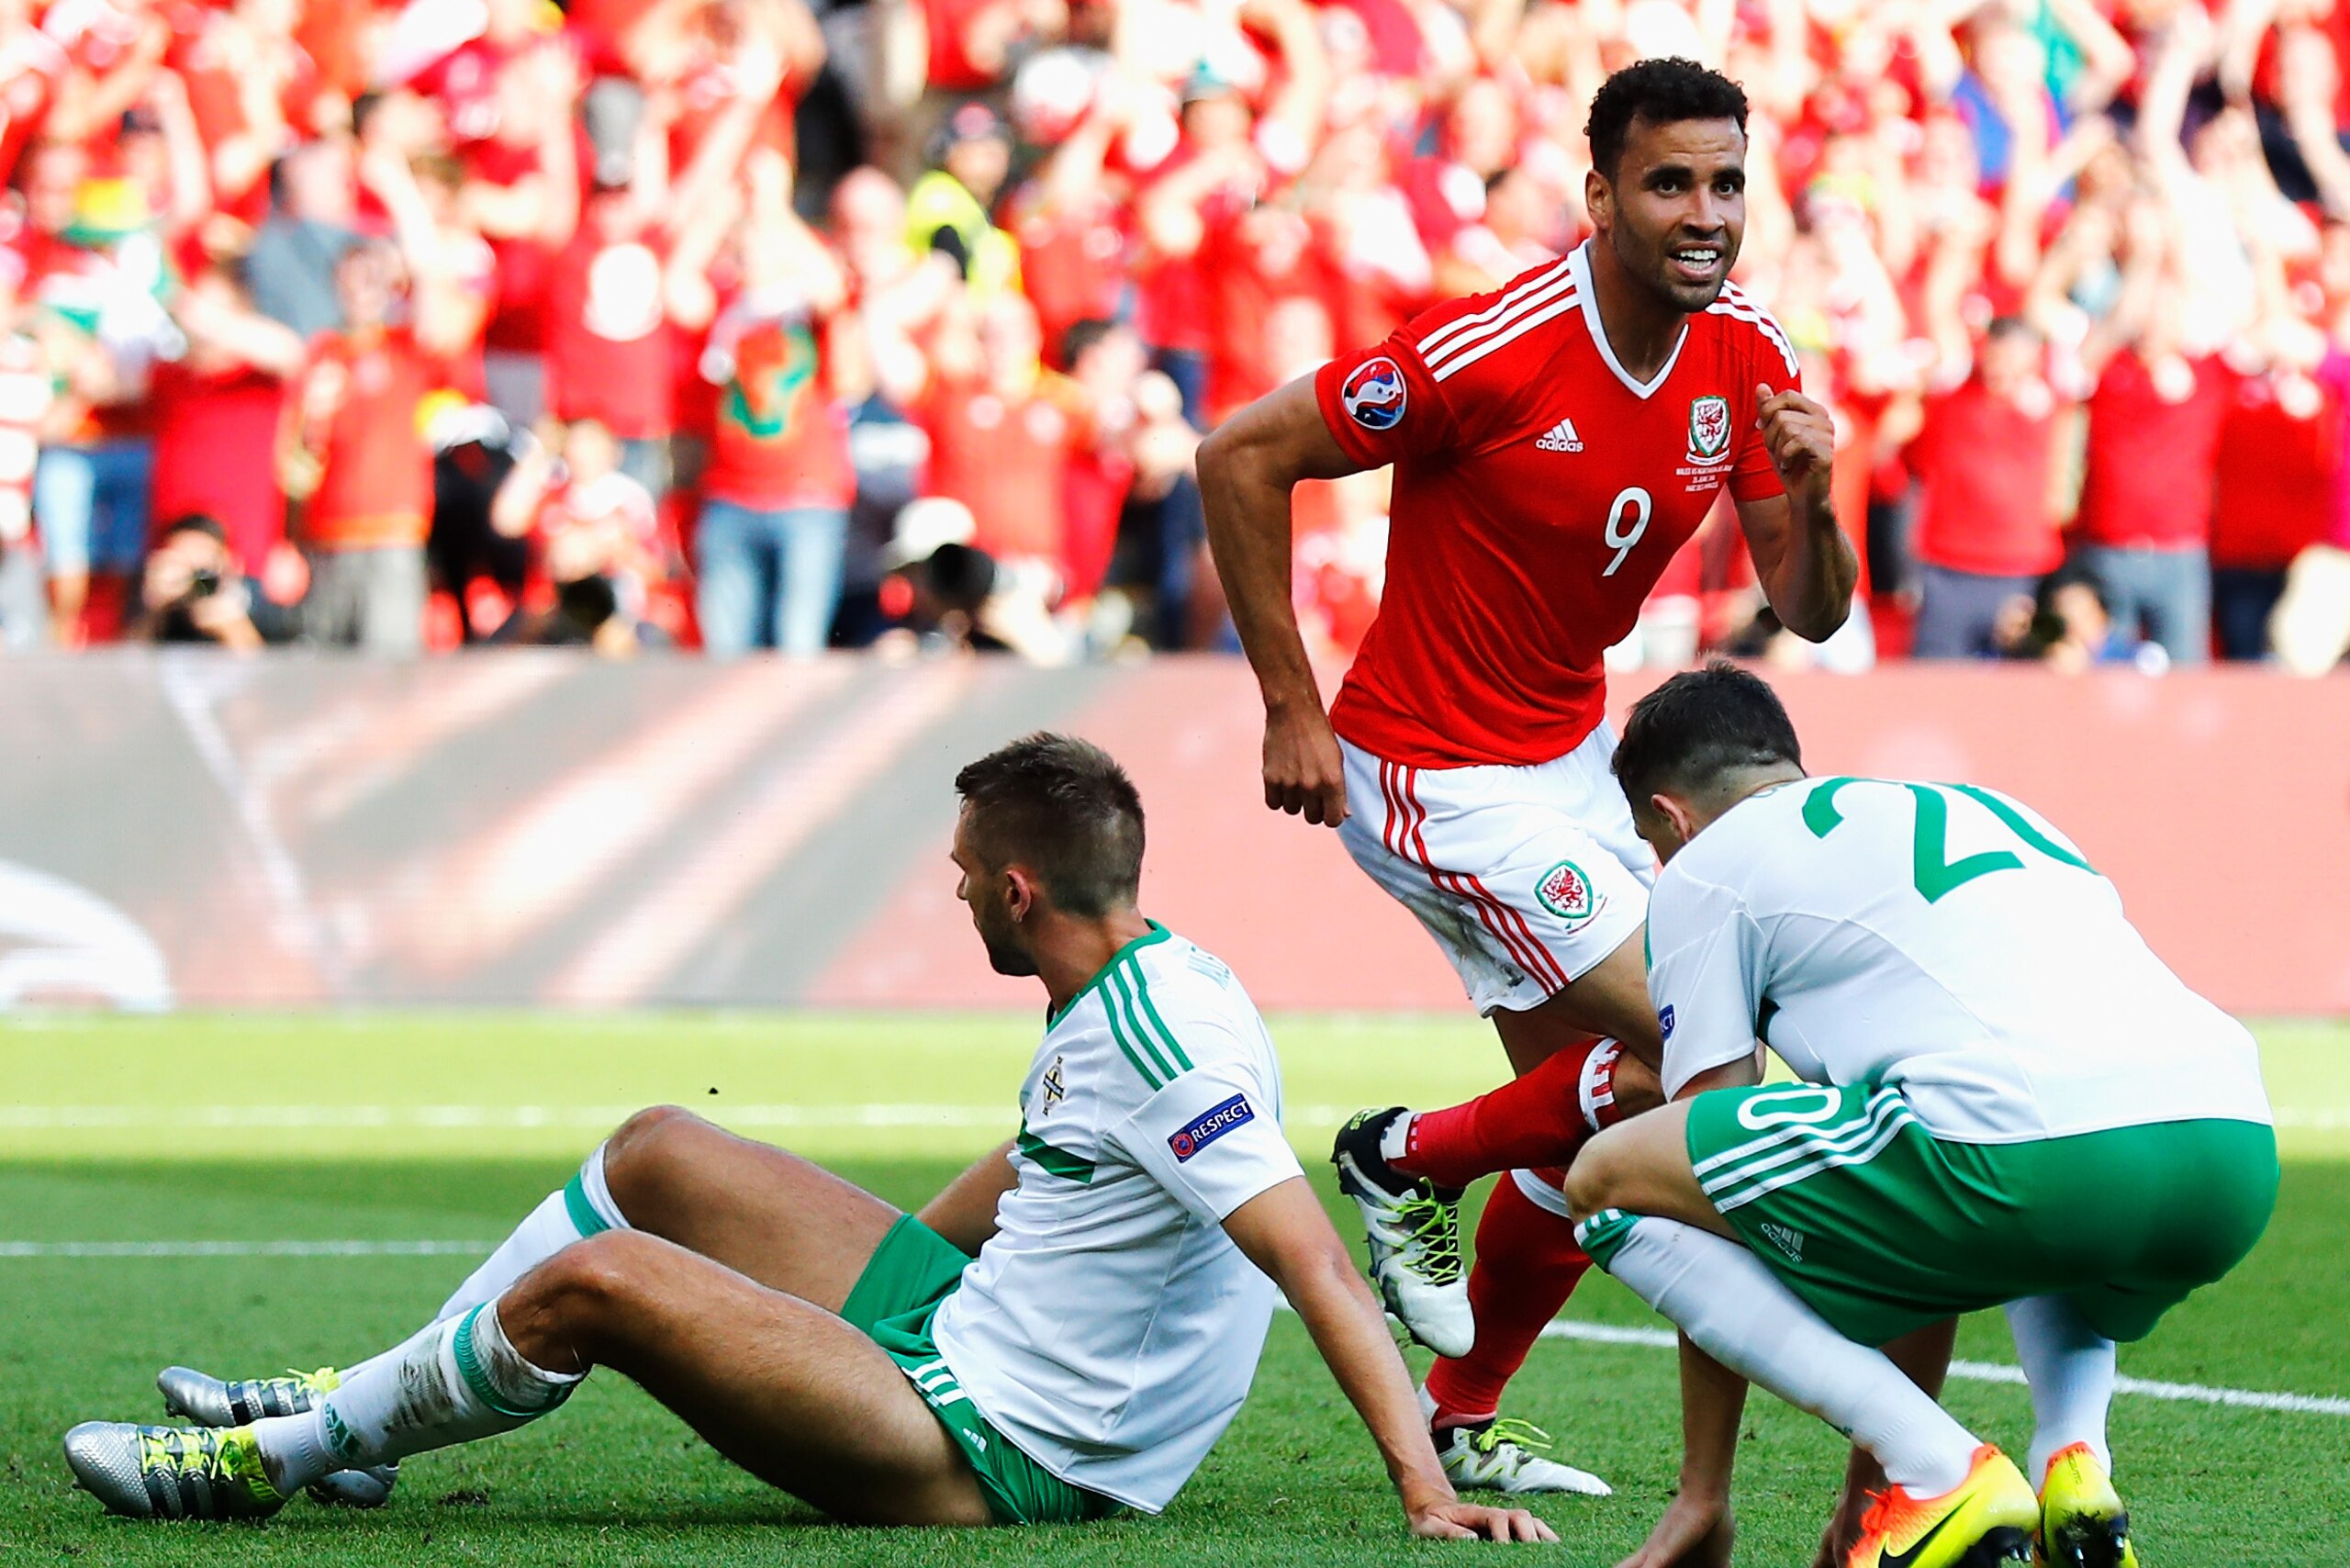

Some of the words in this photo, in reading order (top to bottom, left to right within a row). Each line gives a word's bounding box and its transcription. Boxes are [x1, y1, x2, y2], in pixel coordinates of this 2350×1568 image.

[1535, 438, 1584, 453] adidas
[1602, 487, 1651, 577] 9
[1191, 1101, 1249, 1143] RESPECT
